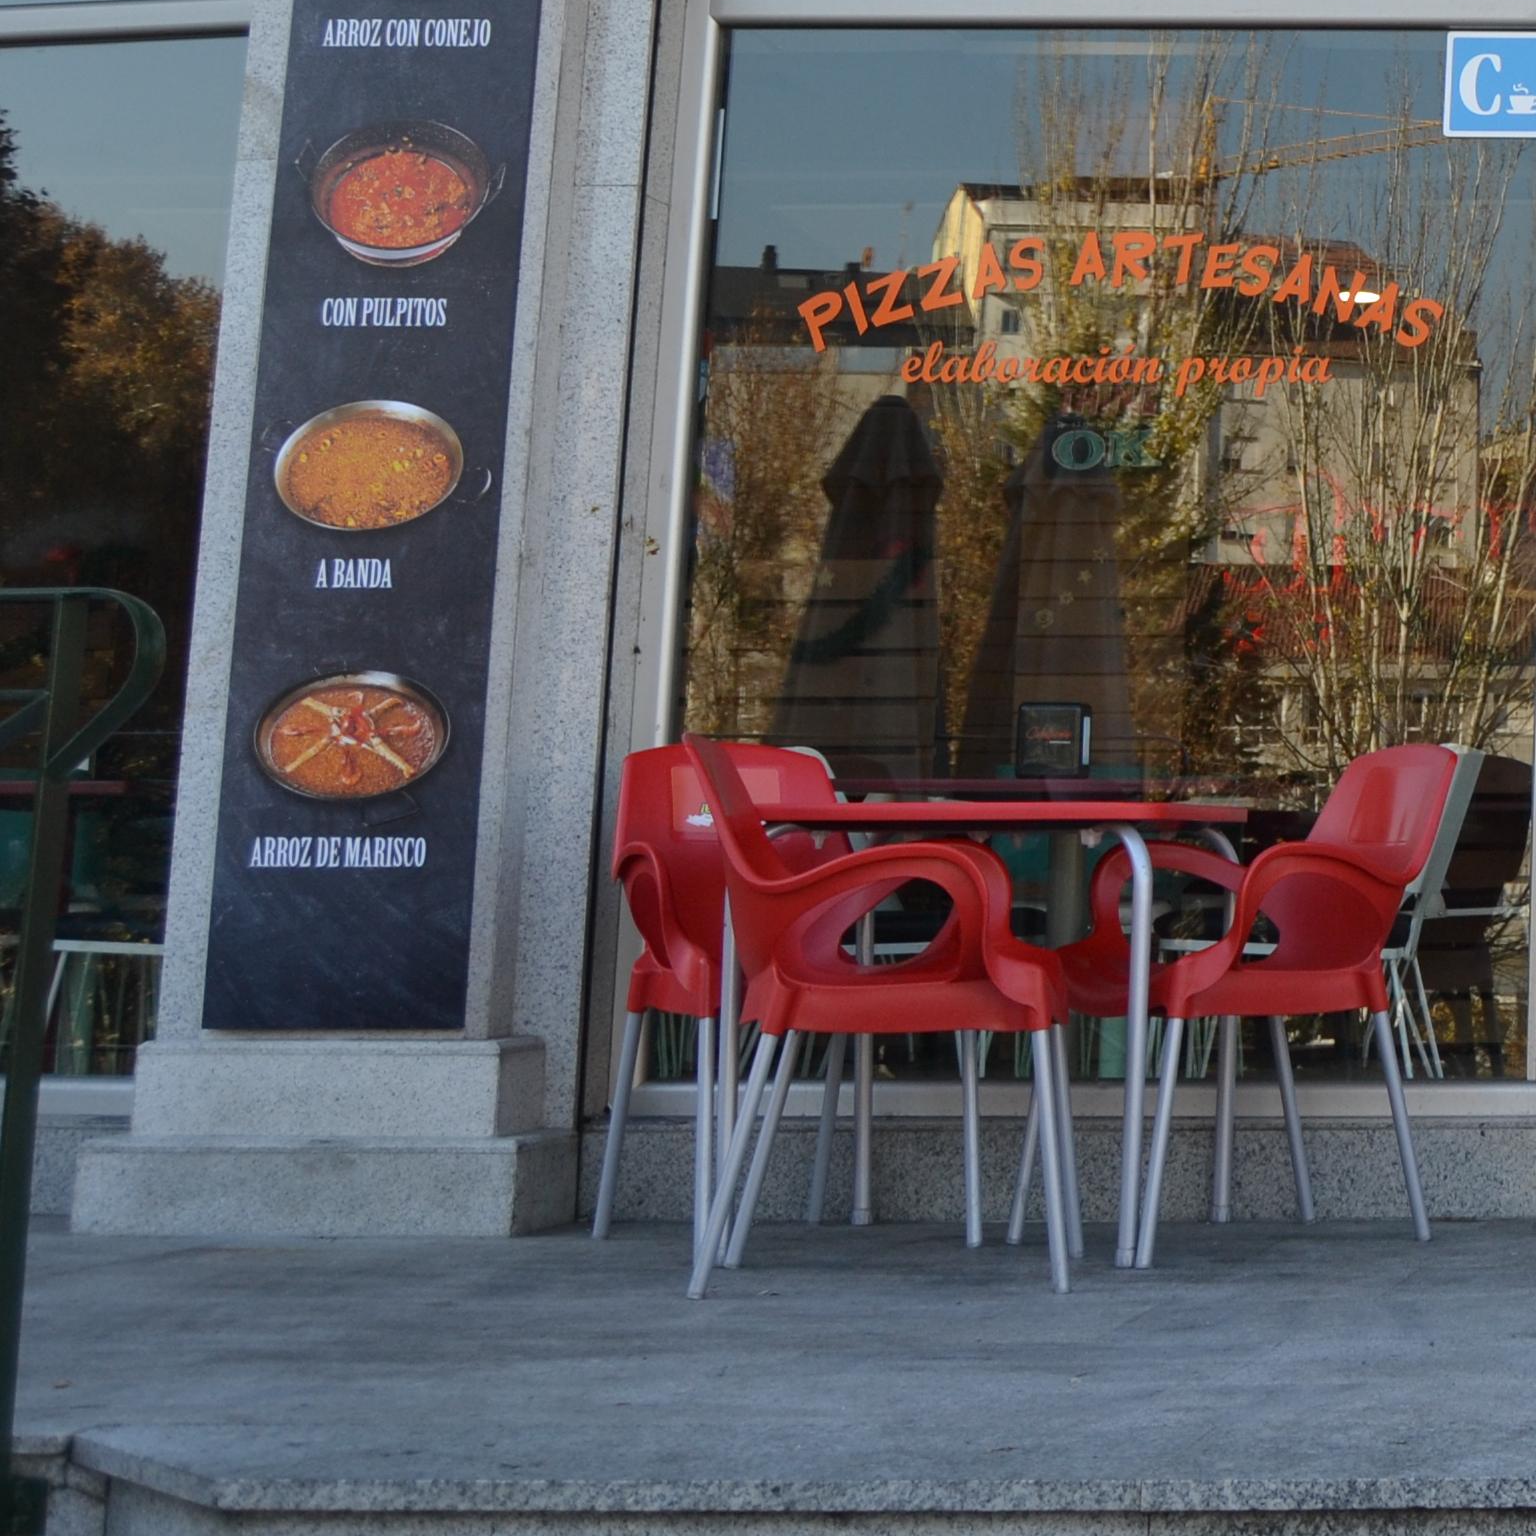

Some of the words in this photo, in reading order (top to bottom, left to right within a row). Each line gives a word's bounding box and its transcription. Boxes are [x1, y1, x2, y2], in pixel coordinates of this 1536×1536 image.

[322, 19, 382, 47] ARROZ
[385, 19, 420, 47] CON
[424, 19, 491, 47] CONEJO
[797, 237, 1046, 353] PIZZAS
[1069, 230, 1445, 348] ARTESANAS
[322, 297, 358, 327] CON
[360, 297, 447, 327] PULPITOS
[900, 340, 1166, 386] elaboración
[1173, 345, 1333, 397] propia
[315, 558, 328, 589] A
[331, 558, 392, 589] BANDA
[249, 837, 313, 867] ARROZ
[315, 837, 340, 867] DE
[344, 837, 426, 867] MARISCO
